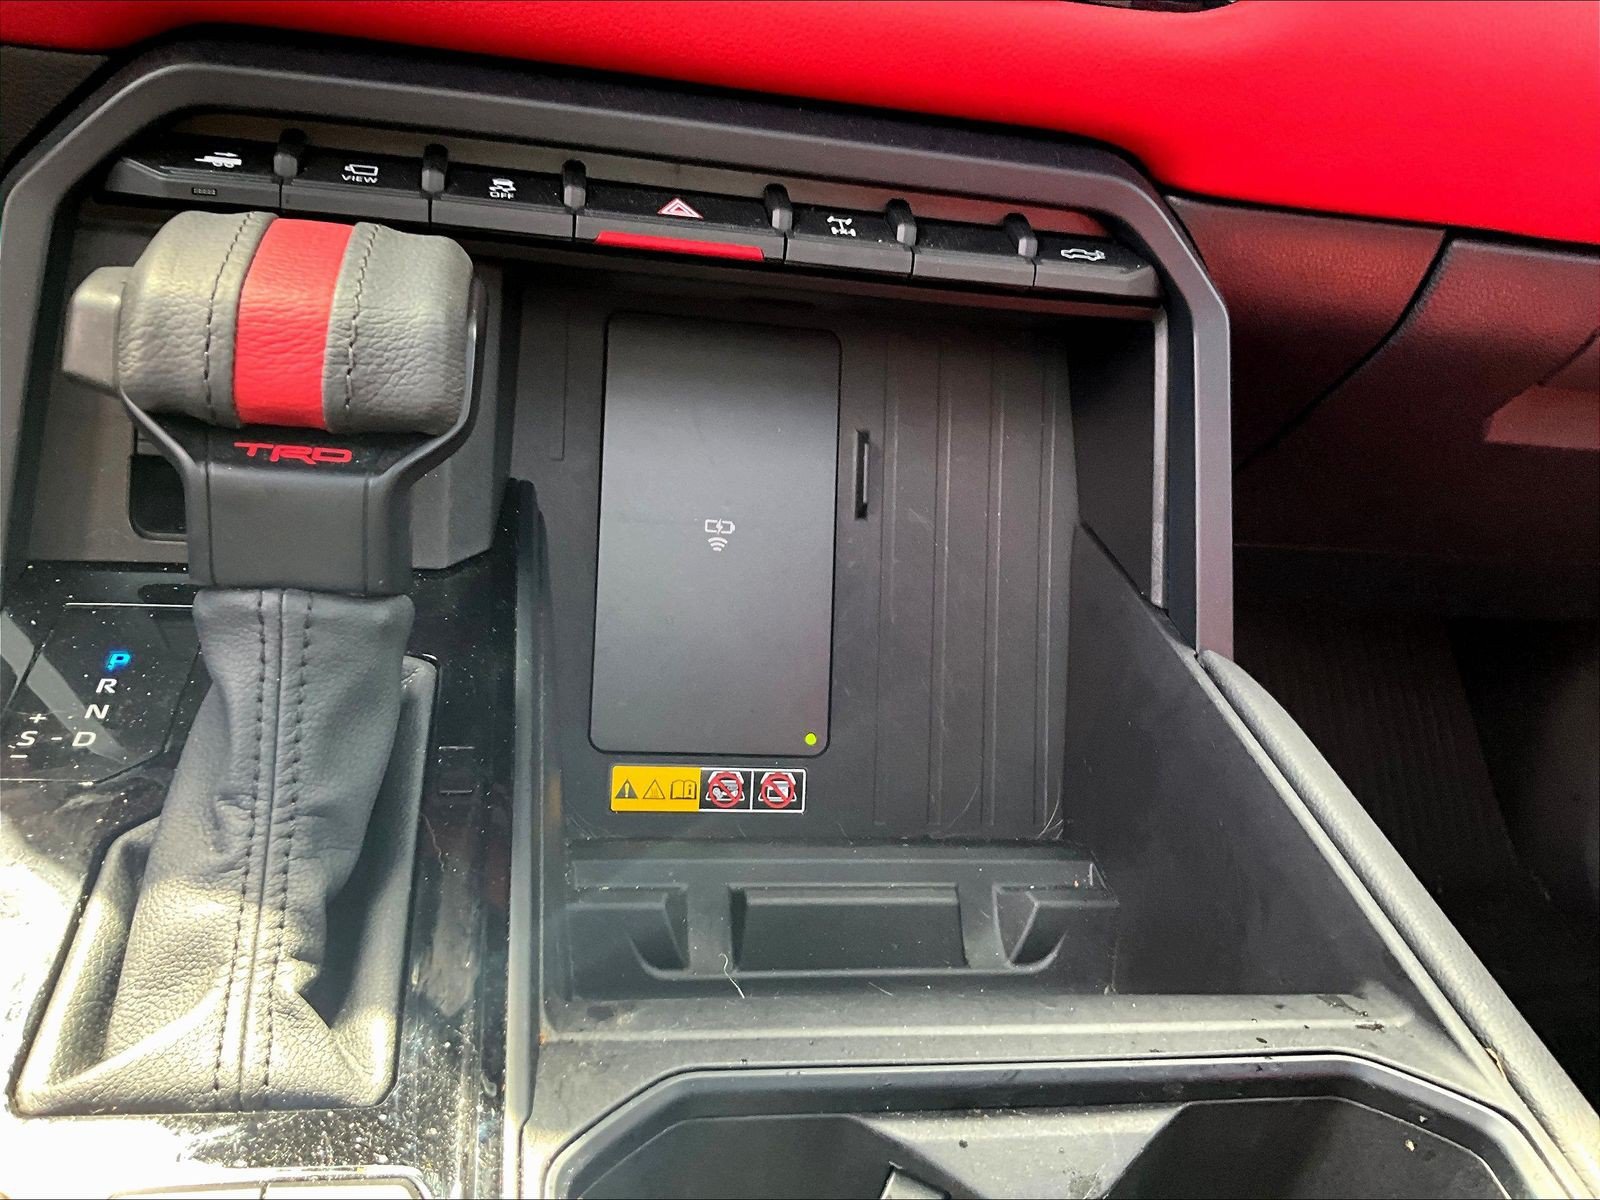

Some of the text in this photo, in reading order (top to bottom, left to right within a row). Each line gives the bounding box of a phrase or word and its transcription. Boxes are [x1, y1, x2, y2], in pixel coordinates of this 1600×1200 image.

[341, 174, 378, 184] VIEW
[489, 191, 515, 200] OFF
[233, 442, 353, 465] TRD
[105, 652, 132, 671] P
[95, 678, 118, 694] R
[84, 703, 110, 719] N
[16, 730, 97, 747] S D
